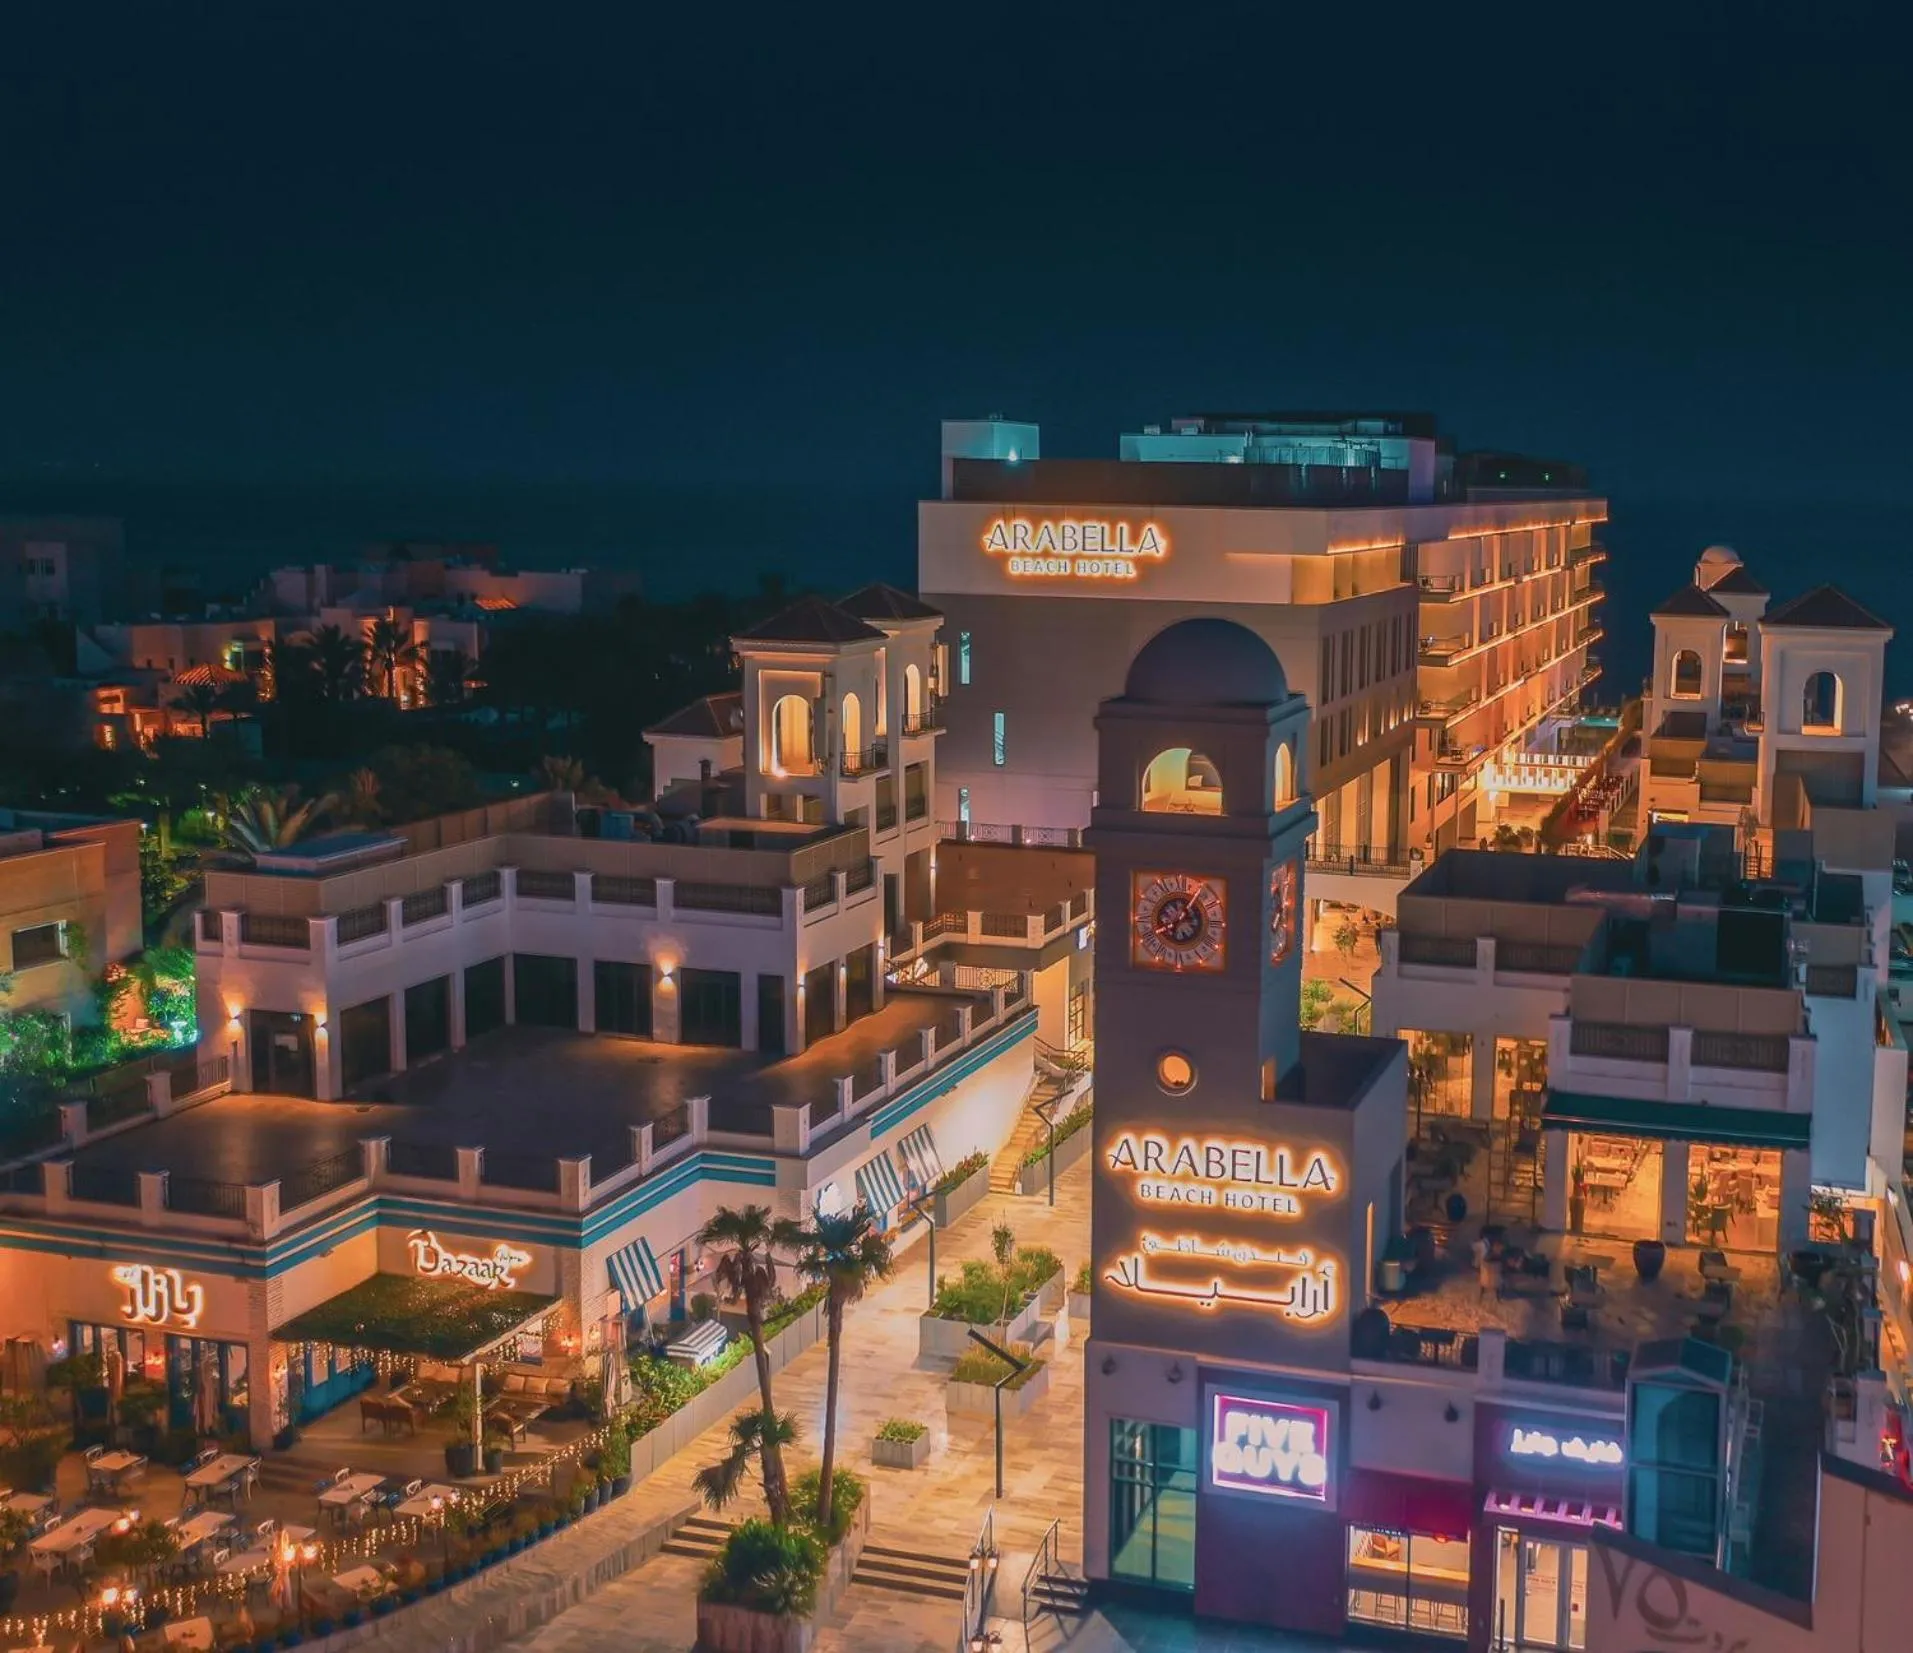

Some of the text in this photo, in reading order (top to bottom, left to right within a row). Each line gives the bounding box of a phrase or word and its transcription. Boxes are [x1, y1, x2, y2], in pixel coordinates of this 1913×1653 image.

[985, 523, 1162, 554] ARABELLA
[1010, 559, 1134, 575] BEACH HOTEL
[1108, 1138, 1335, 1191] ARABELLA
[1140, 1183, 1298, 1214] BEACH HOTEL
